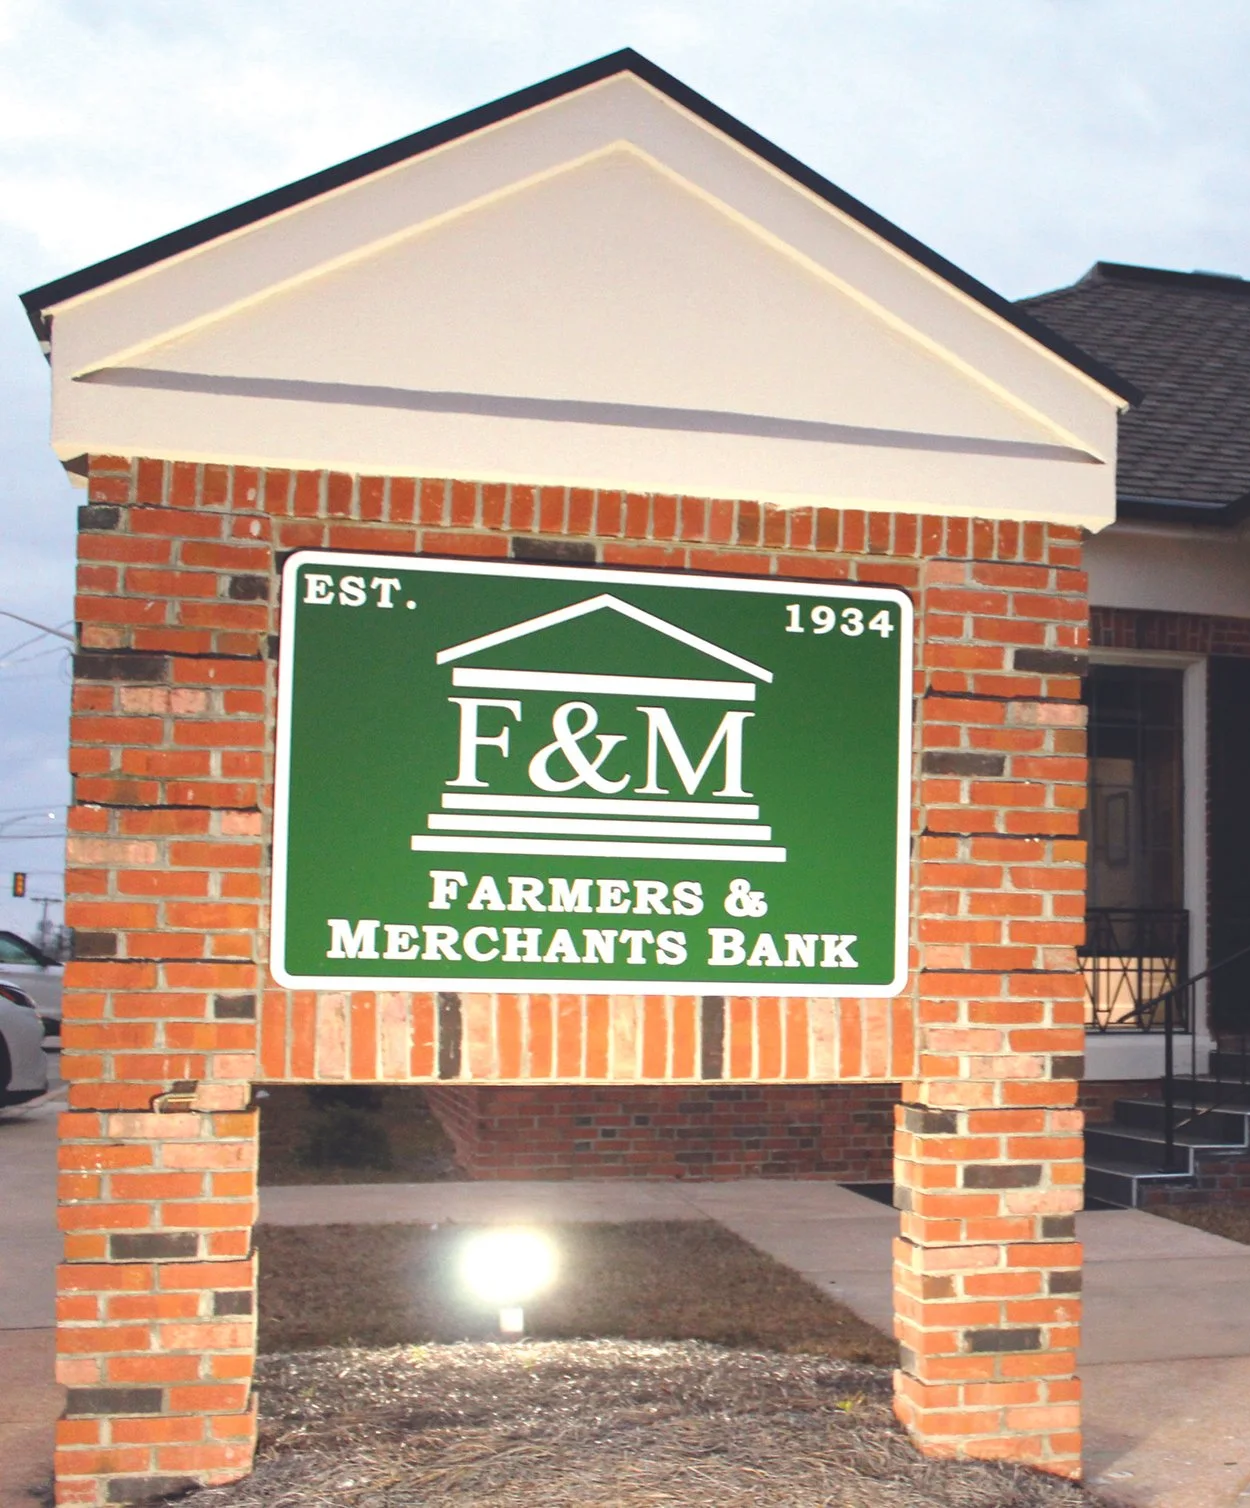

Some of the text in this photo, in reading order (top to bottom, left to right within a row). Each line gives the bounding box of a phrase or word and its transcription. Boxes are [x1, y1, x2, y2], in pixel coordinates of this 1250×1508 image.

[303, 574, 417, 610] EST.
[785, 604, 894, 638] 1934
[445, 697, 755, 797] F&M
[428, 871, 768, 918] FARMERS &
[326, 919, 859, 969] MERCHANTS BANK
